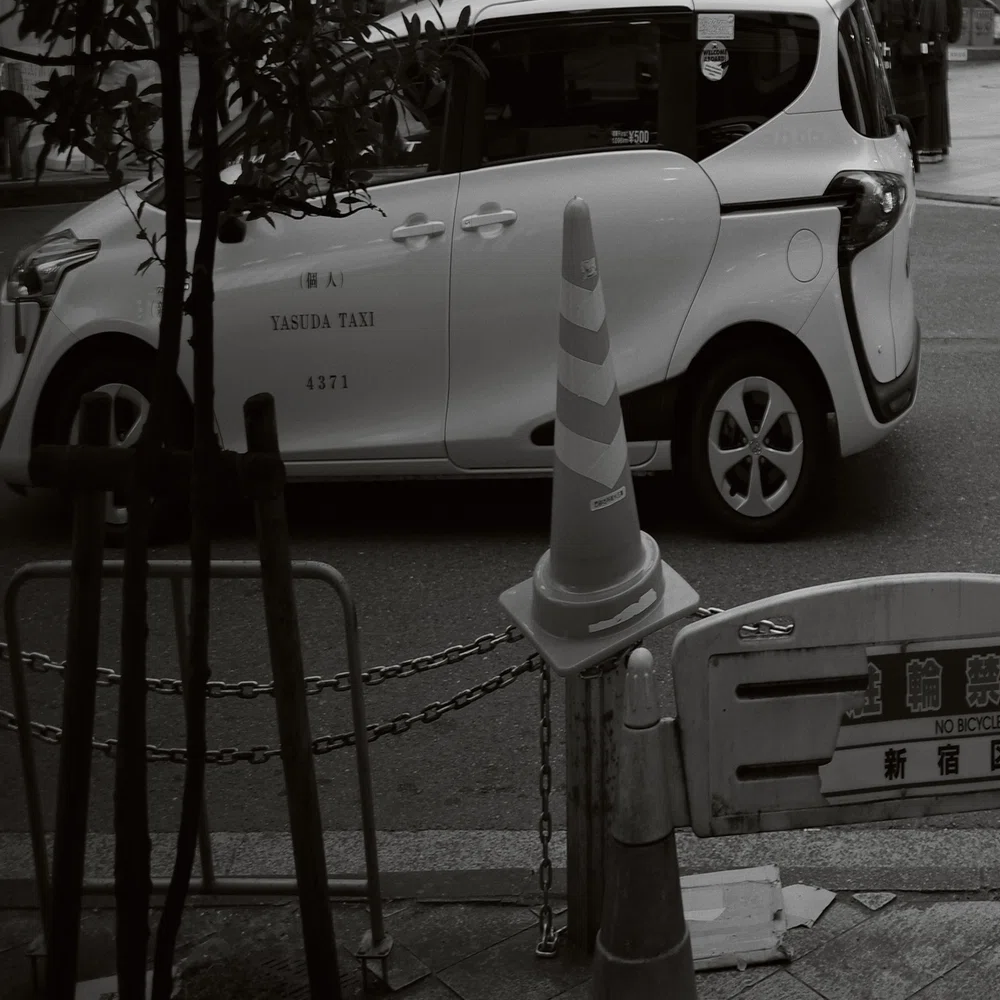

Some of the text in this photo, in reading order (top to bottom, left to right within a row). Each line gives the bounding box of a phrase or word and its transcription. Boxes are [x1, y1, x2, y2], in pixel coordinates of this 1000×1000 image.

[628, 130, 650, 144] ¥500
[299, 271, 344, 289] (個人)
[270, 311, 375, 332] YASUDA TAXI
[305, 374, 349, 391] 4371
[934, 718, 954, 736] NO
